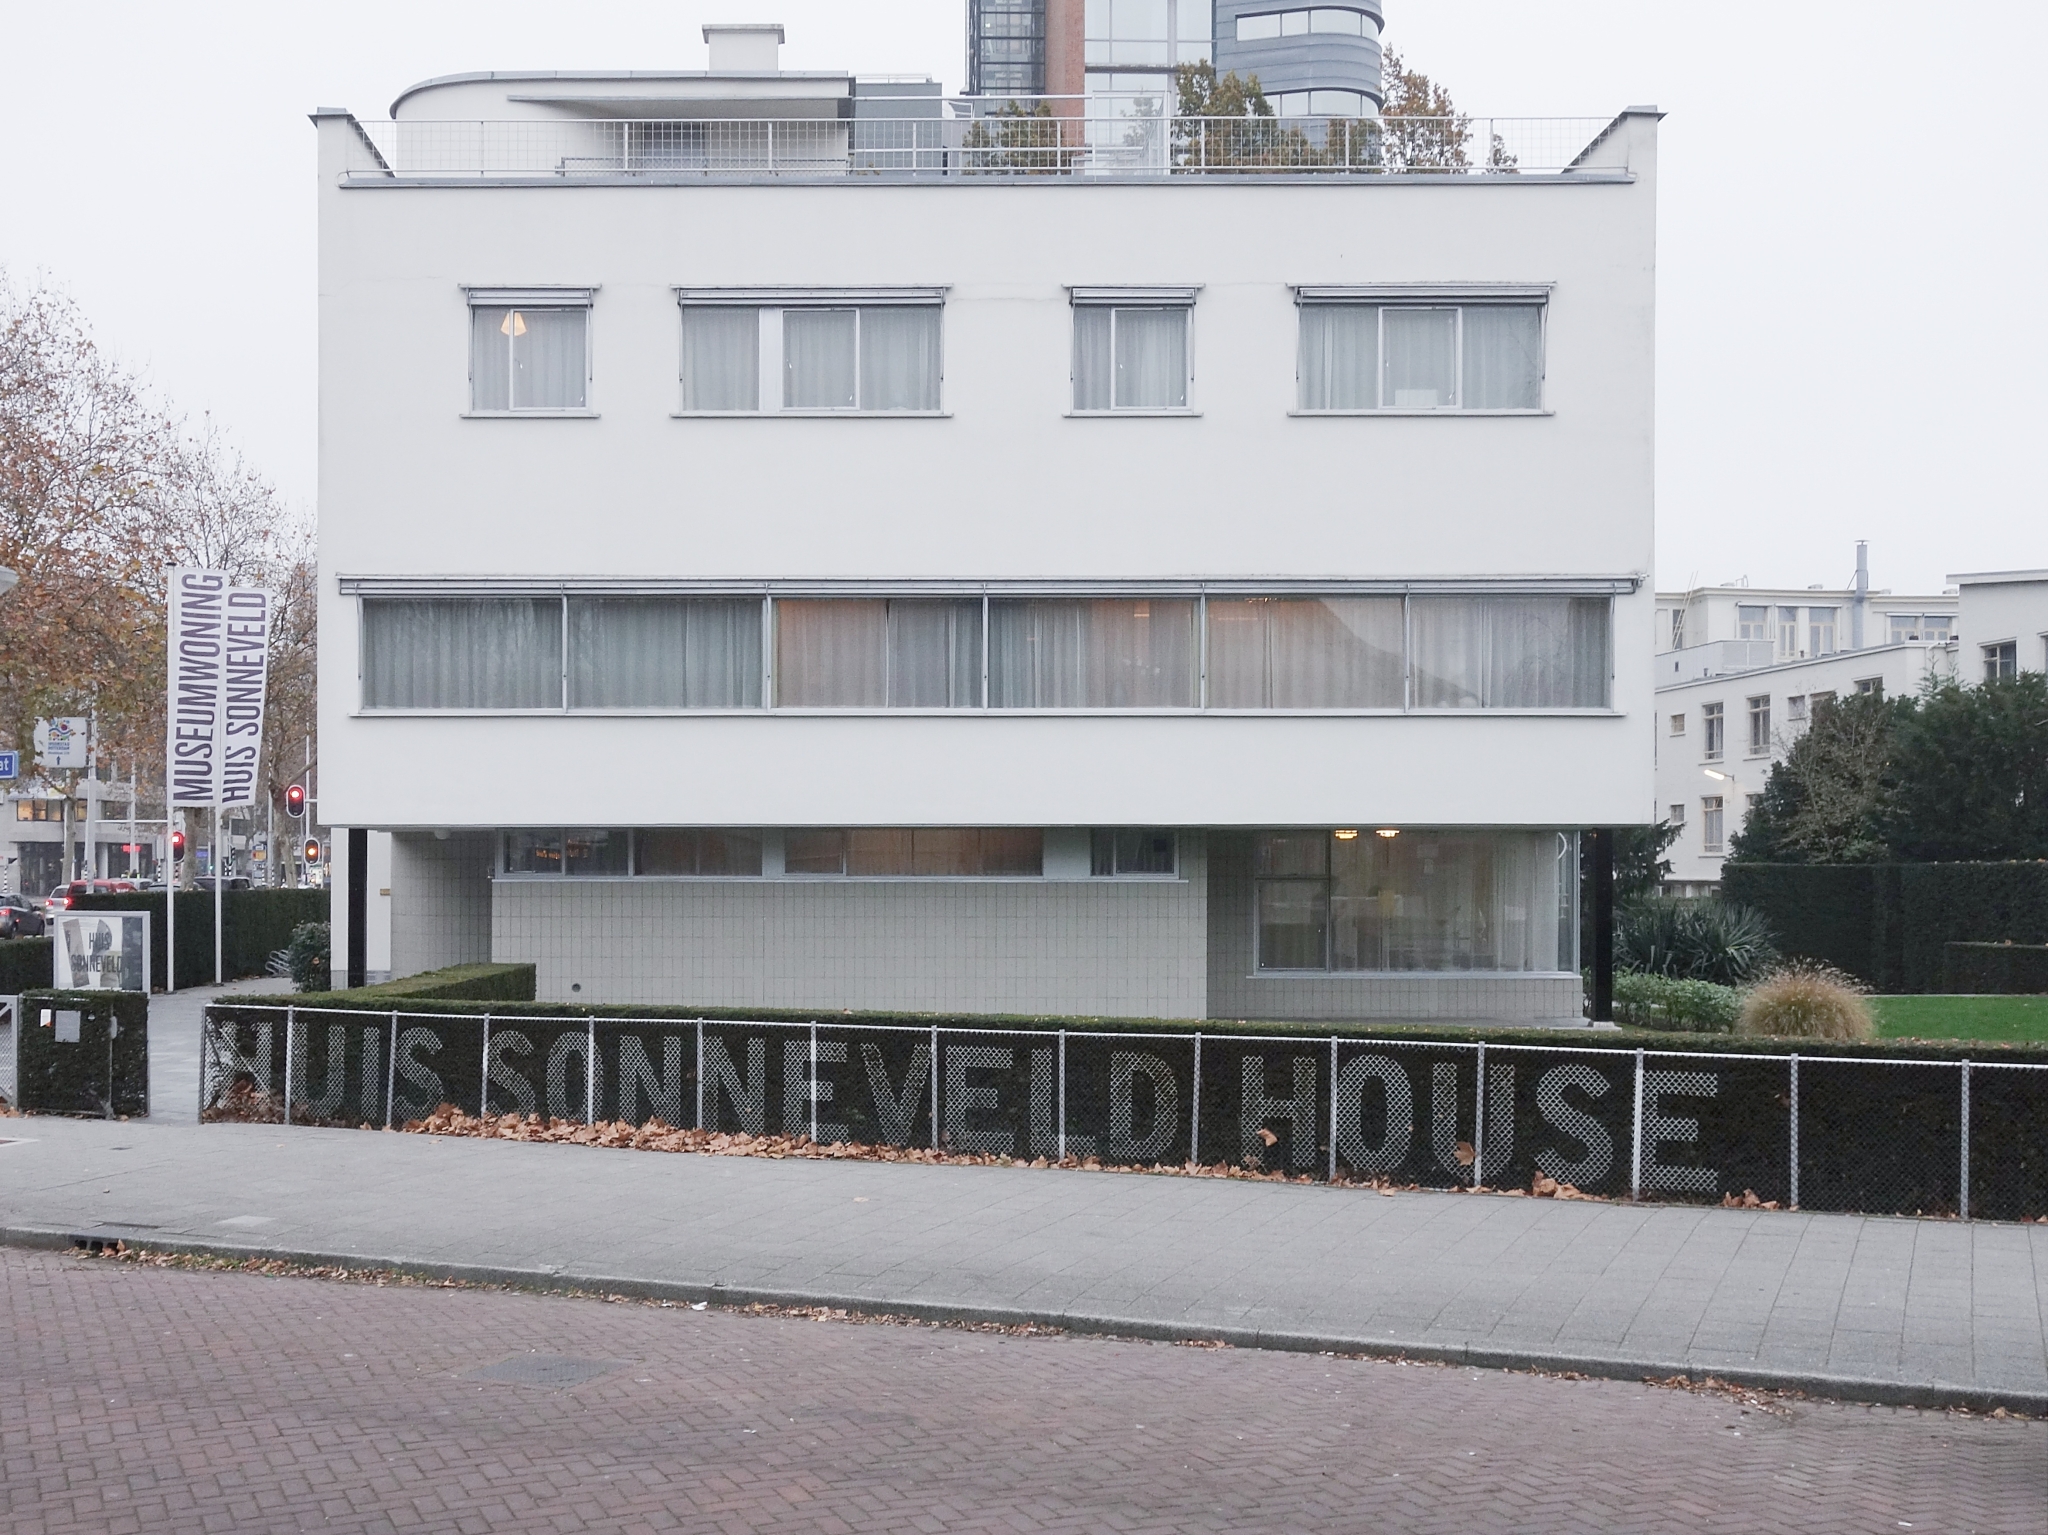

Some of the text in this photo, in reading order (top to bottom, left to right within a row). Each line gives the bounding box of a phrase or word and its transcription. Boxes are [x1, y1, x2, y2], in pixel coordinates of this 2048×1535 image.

[173, 574, 223, 801] MUSEUMWONING
[222, 592, 266, 803] HUIS SONNEVELD
[88, 932, 110, 949] HUIS
[219, 1020, 1720, 1192] HUIS SONNEVELD HOUSE
